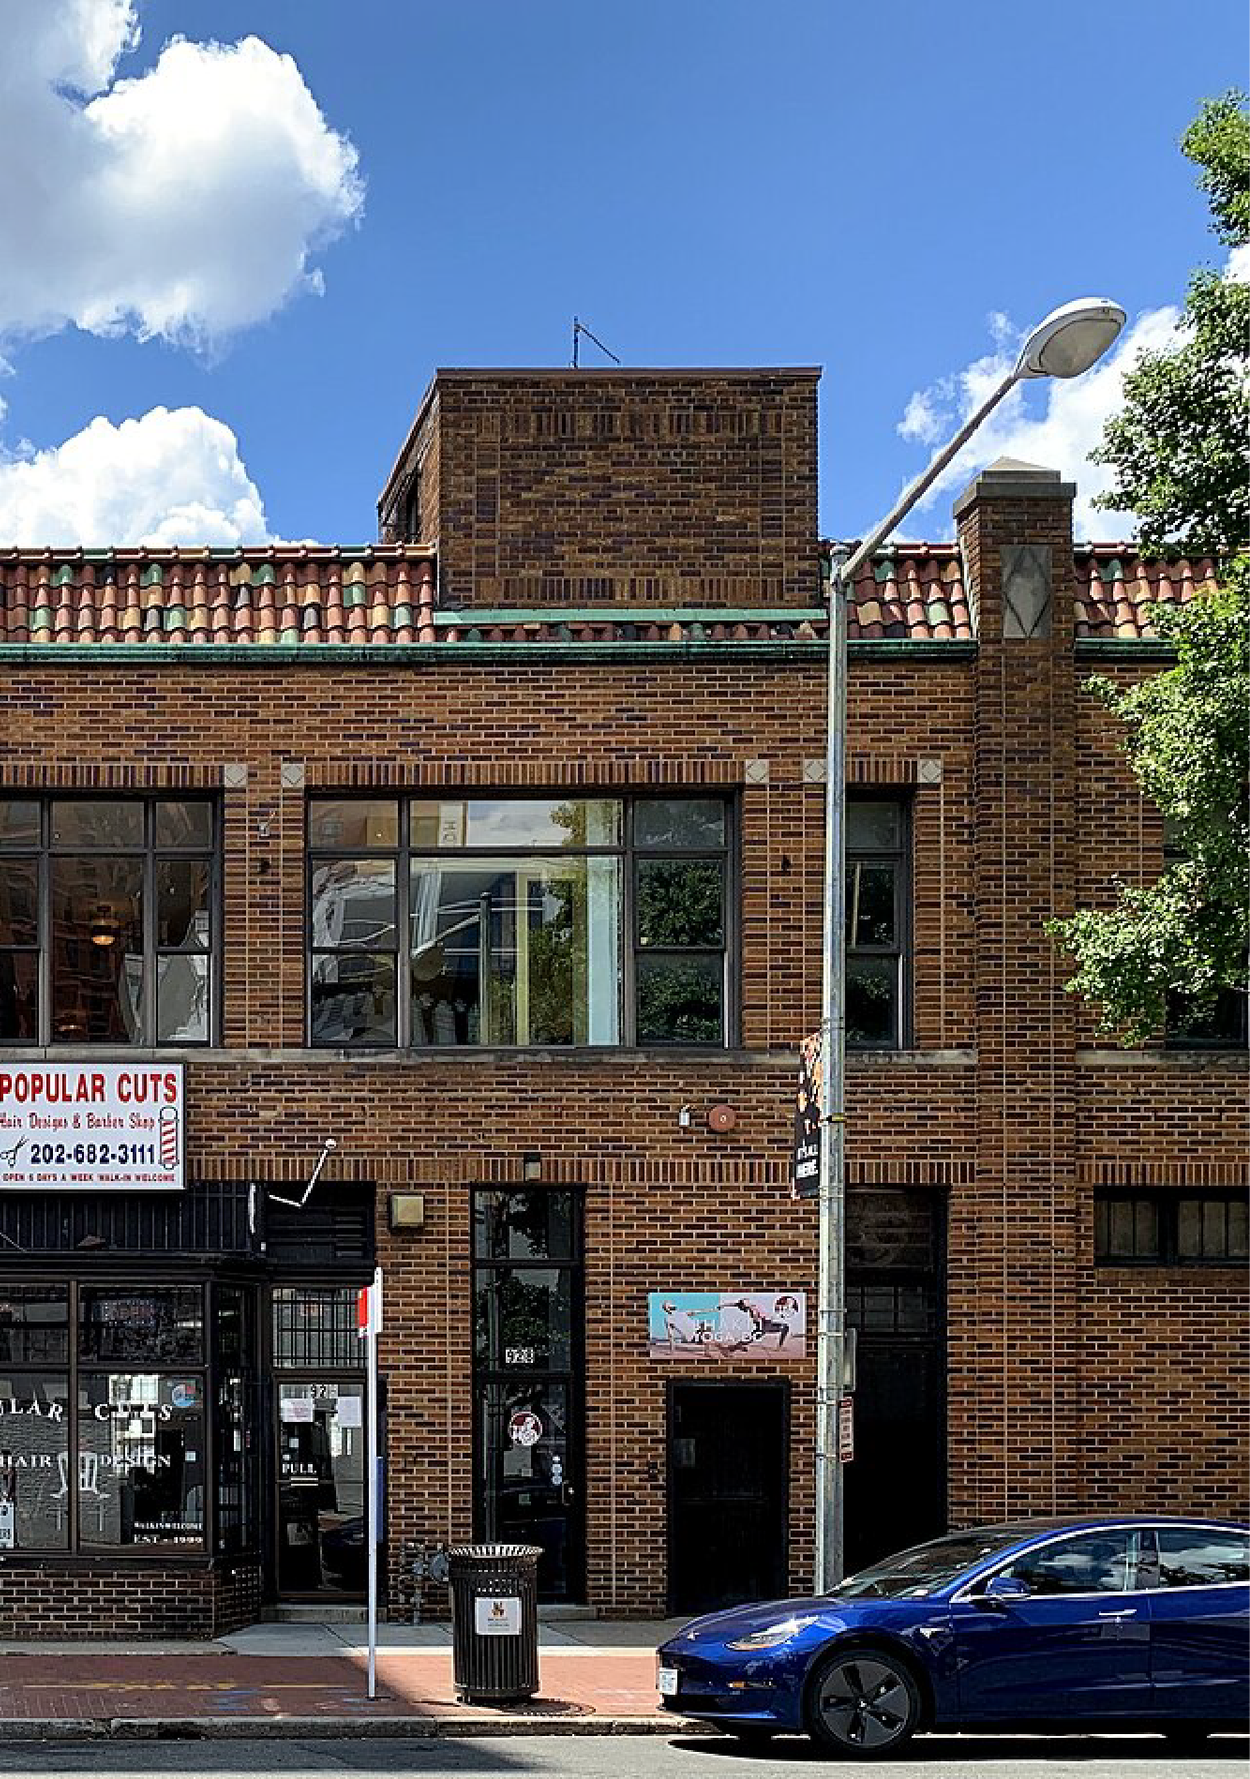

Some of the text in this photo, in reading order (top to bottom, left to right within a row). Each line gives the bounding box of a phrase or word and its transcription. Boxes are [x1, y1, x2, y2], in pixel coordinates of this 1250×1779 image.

[0, 1073, 177, 1103] POPULAR CUTS
[30, 1143, 155, 1165] 202-682-3111
[3, 1173, 25, 1182] OPEN
[37, 1173, 58, 1182] DAYS
[70, 1173, 94, 1182] WEEK
[135, 1173, 176, 1182] WELCOME
[0, 1454, 51, 1468] HAIR
